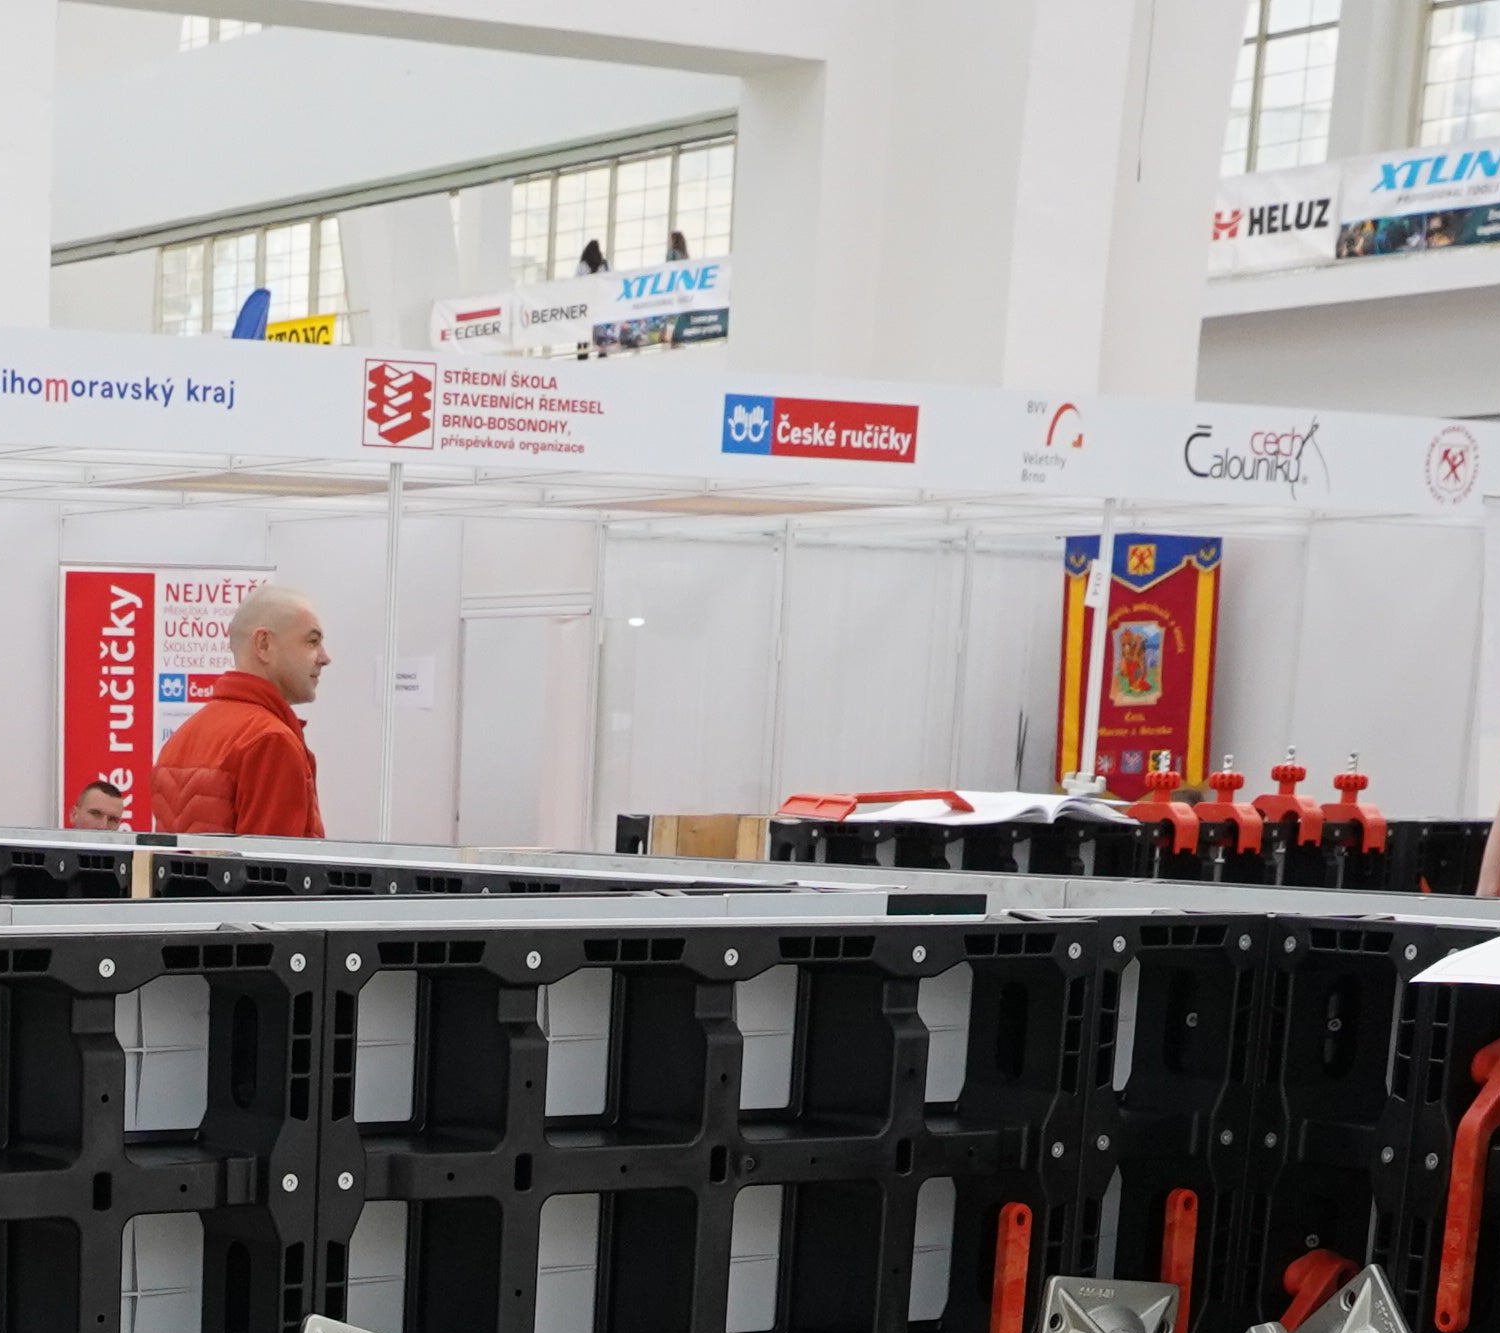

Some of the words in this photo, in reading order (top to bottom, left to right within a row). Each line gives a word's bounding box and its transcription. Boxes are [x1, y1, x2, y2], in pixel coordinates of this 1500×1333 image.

[1247, 198, 1331, 237] HELUZ
[616, 264, 720, 302] XTLINE
[530, 303, 588, 324] BERNER
[454, 321, 501, 340] EGGER
[443, 367, 507, 387] STŘEDNÍ
[511, 371, 558, 390] ŠKOLA
[186, 377, 235, 410] kraj
[442, 391, 535, 411] STAVEBNÍCH
[538, 394, 605, 415] ŘEMESEL
[1026, 400, 1048, 415] BVV
[441, 413, 572, 436] BRNO-BOSONOHY,
[776, 413, 837, 447] České
[840, 423, 913, 456] ručičky
[440, 434, 516, 451] příspěvková
[519, 440, 585, 455] organizace
[1022, 451, 1067, 469] Veletrhy
[1020, 468, 1047, 484] Brno
[165, 578, 267, 604] NEJVĚT
[164, 617, 230, 639] UČŇOV
[163, 640, 209, 652] ŠKOLSTVÍ
[211, 642, 218, 652] A
[99, 585, 143, 752] ručičky
[163, 656, 170, 667] V
[173, 655, 207, 667] ČESKÉ
[209, 656, 235, 668] REPU
[188, 682, 214, 698] Čes
